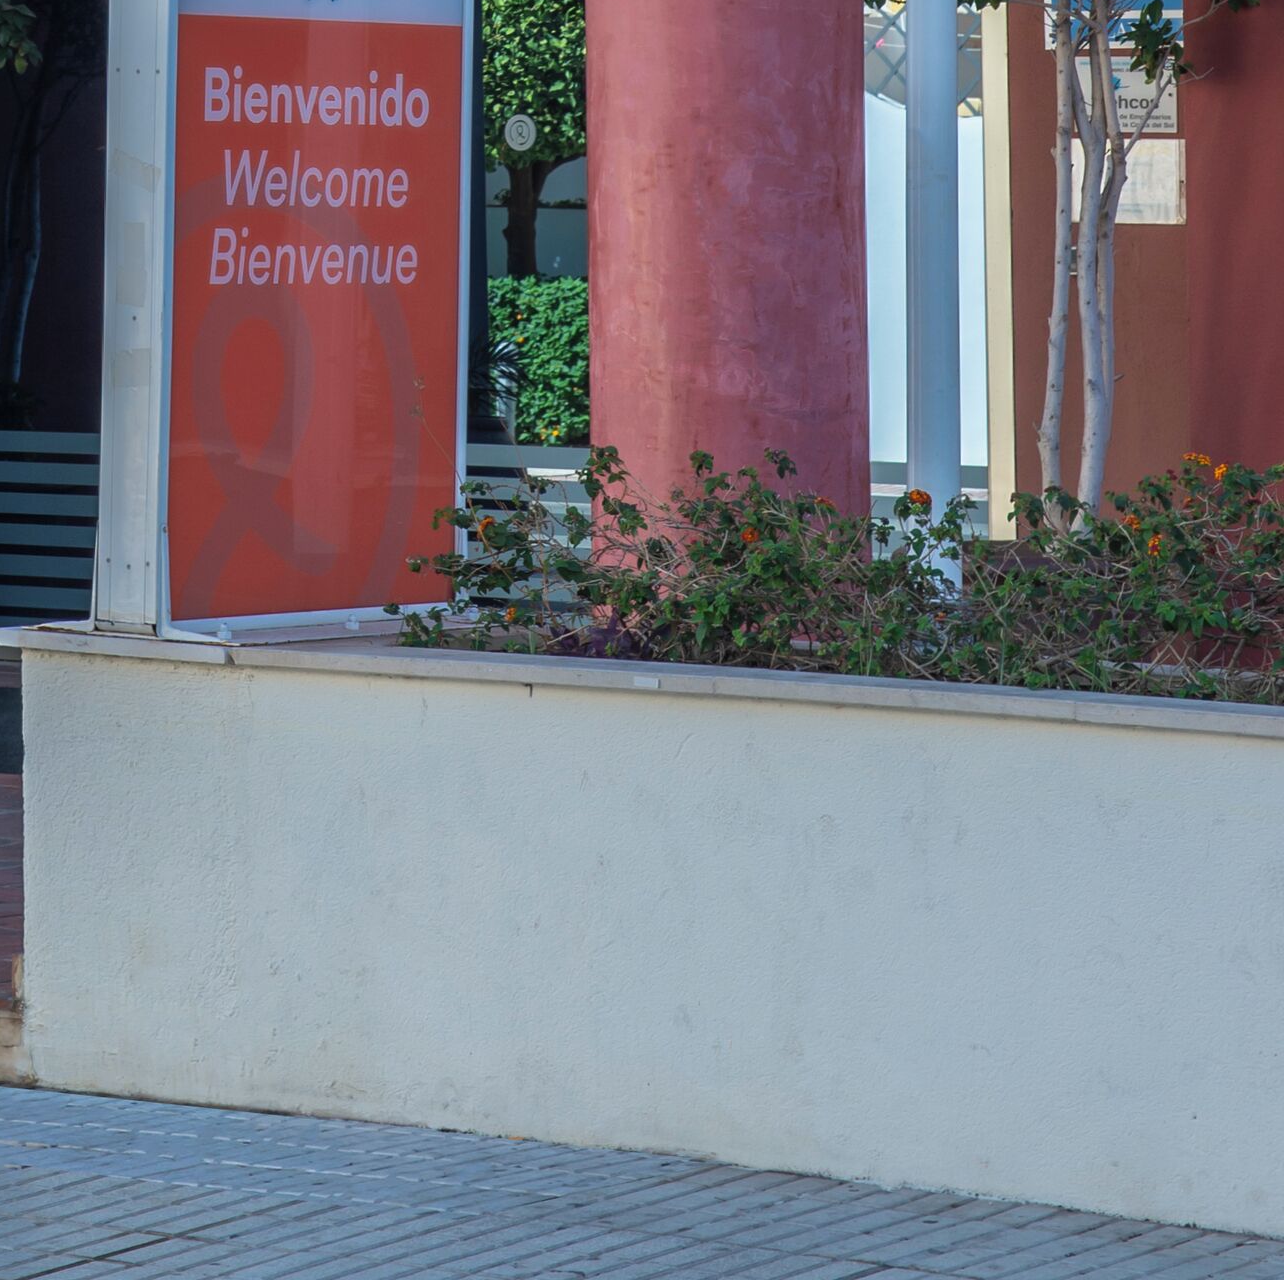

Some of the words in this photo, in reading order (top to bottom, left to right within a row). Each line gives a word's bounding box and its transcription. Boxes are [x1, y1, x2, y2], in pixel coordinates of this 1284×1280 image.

[204, 65, 430, 128] Bienvenido
[223, 149, 409, 208] Welcome
[209, 227, 418, 286] Bienvenue
